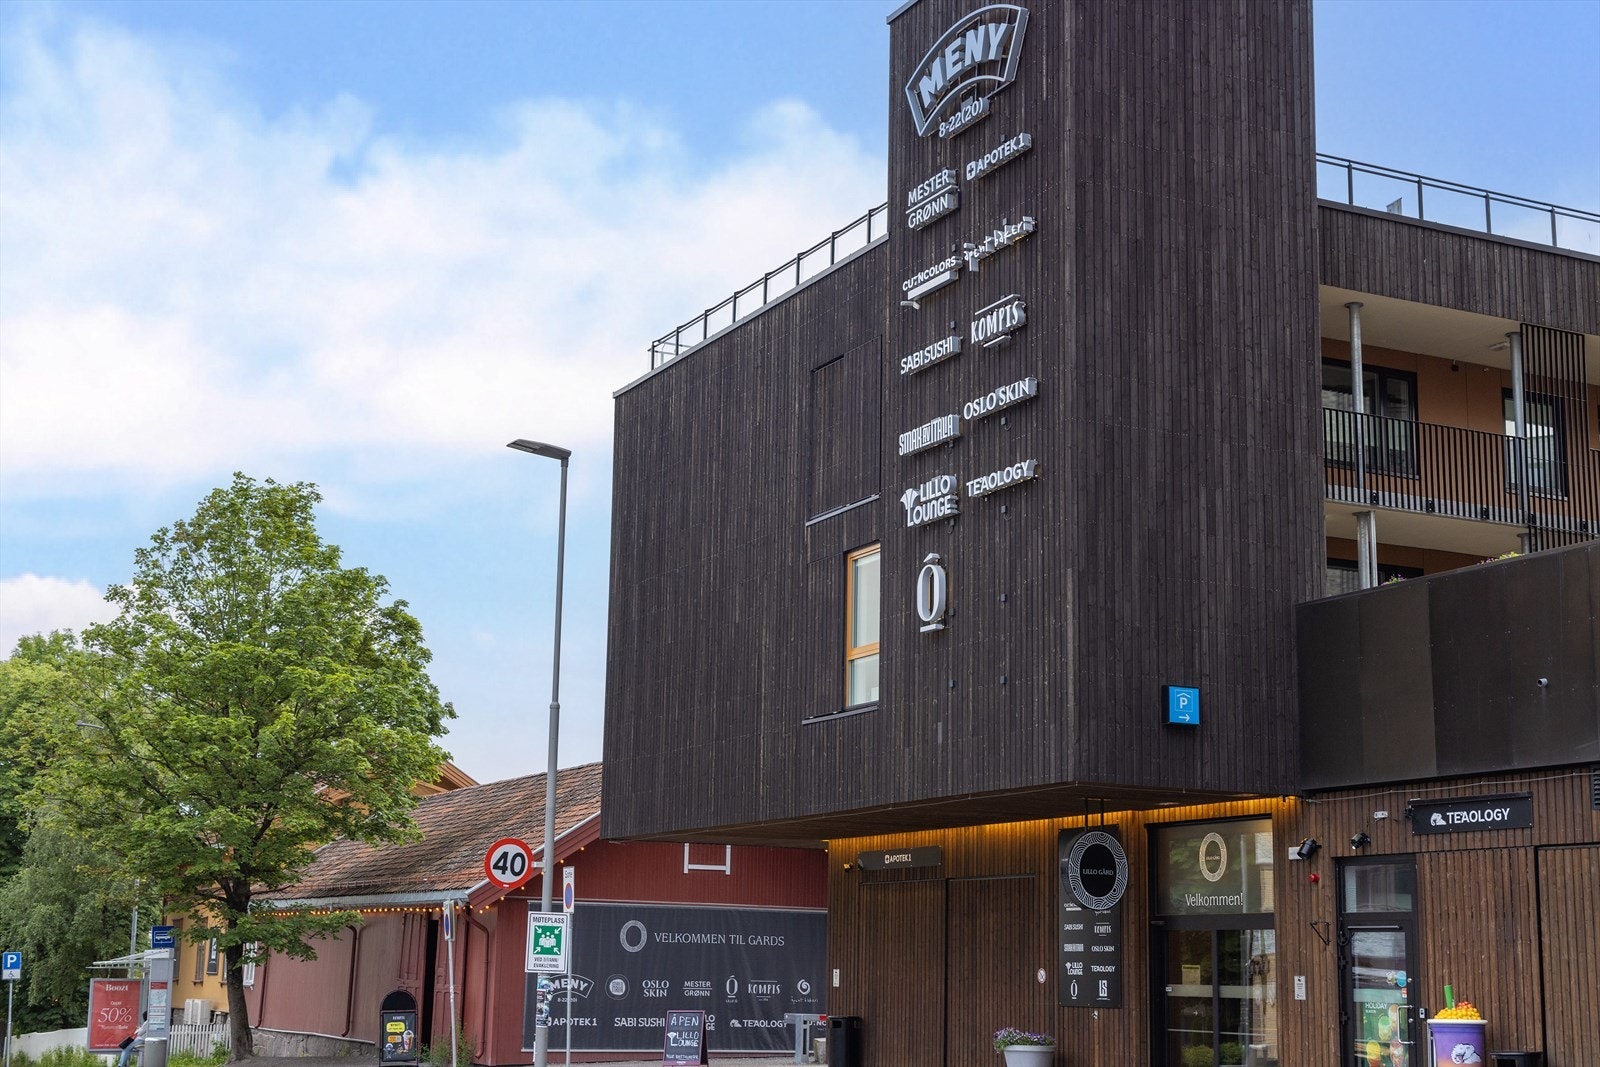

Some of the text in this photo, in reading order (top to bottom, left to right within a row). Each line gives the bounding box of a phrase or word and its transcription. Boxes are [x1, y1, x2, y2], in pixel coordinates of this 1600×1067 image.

[919, 22, 1010, 108] MENY
[939, 98, 984, 138] 8-22(20)
[975, 132, 1026, 174] APOTEK 1
[907, 168, 950, 207] MESTER
[908, 194, 949, 229] GRØNN
[971, 301, 1021, 344] KOMPIS
[900, 336, 954, 375] SABI SUSHI
[963, 379, 1030, 420] OSLO SKIN
[966, 459, 1030, 497] TEAOLOGY
[919, 475, 951, 502] LILLO
[907, 494, 952, 527] LOUNGE
[1180, 697, 1188, 709] P
[1446, 807, 1510, 824] TEAOLOGY
[492, 851, 526, 877] 40
[890, 854, 908, 862] APOTEK
[1098, 868, 1114, 876] GÅRD
[1185, 893, 1244, 907] Velkommen!
[532, 916, 565, 925] MØTEPLASS
[654, 932, 786, 947] VELKOMMEN TIL GARDS
[7, 955, 17, 967] P
[105, 984, 129, 992] Boozt
[551, 979, 588, 991] MENY
[642, 980, 670, 989] OSLO
[748, 983, 781, 994] KOMPIS
[643, 989, 667, 998] SKIN
[684, 989, 711, 997] GRØNN
[98, 1007, 132, 1023] 50%
[592, 1017, 598, 1026] 1
[614, 1017, 665, 1027] SABI SUSHI
[671, 1014, 699, 1026] ÅPEN
[676, 1031, 700, 1040] LILLO
